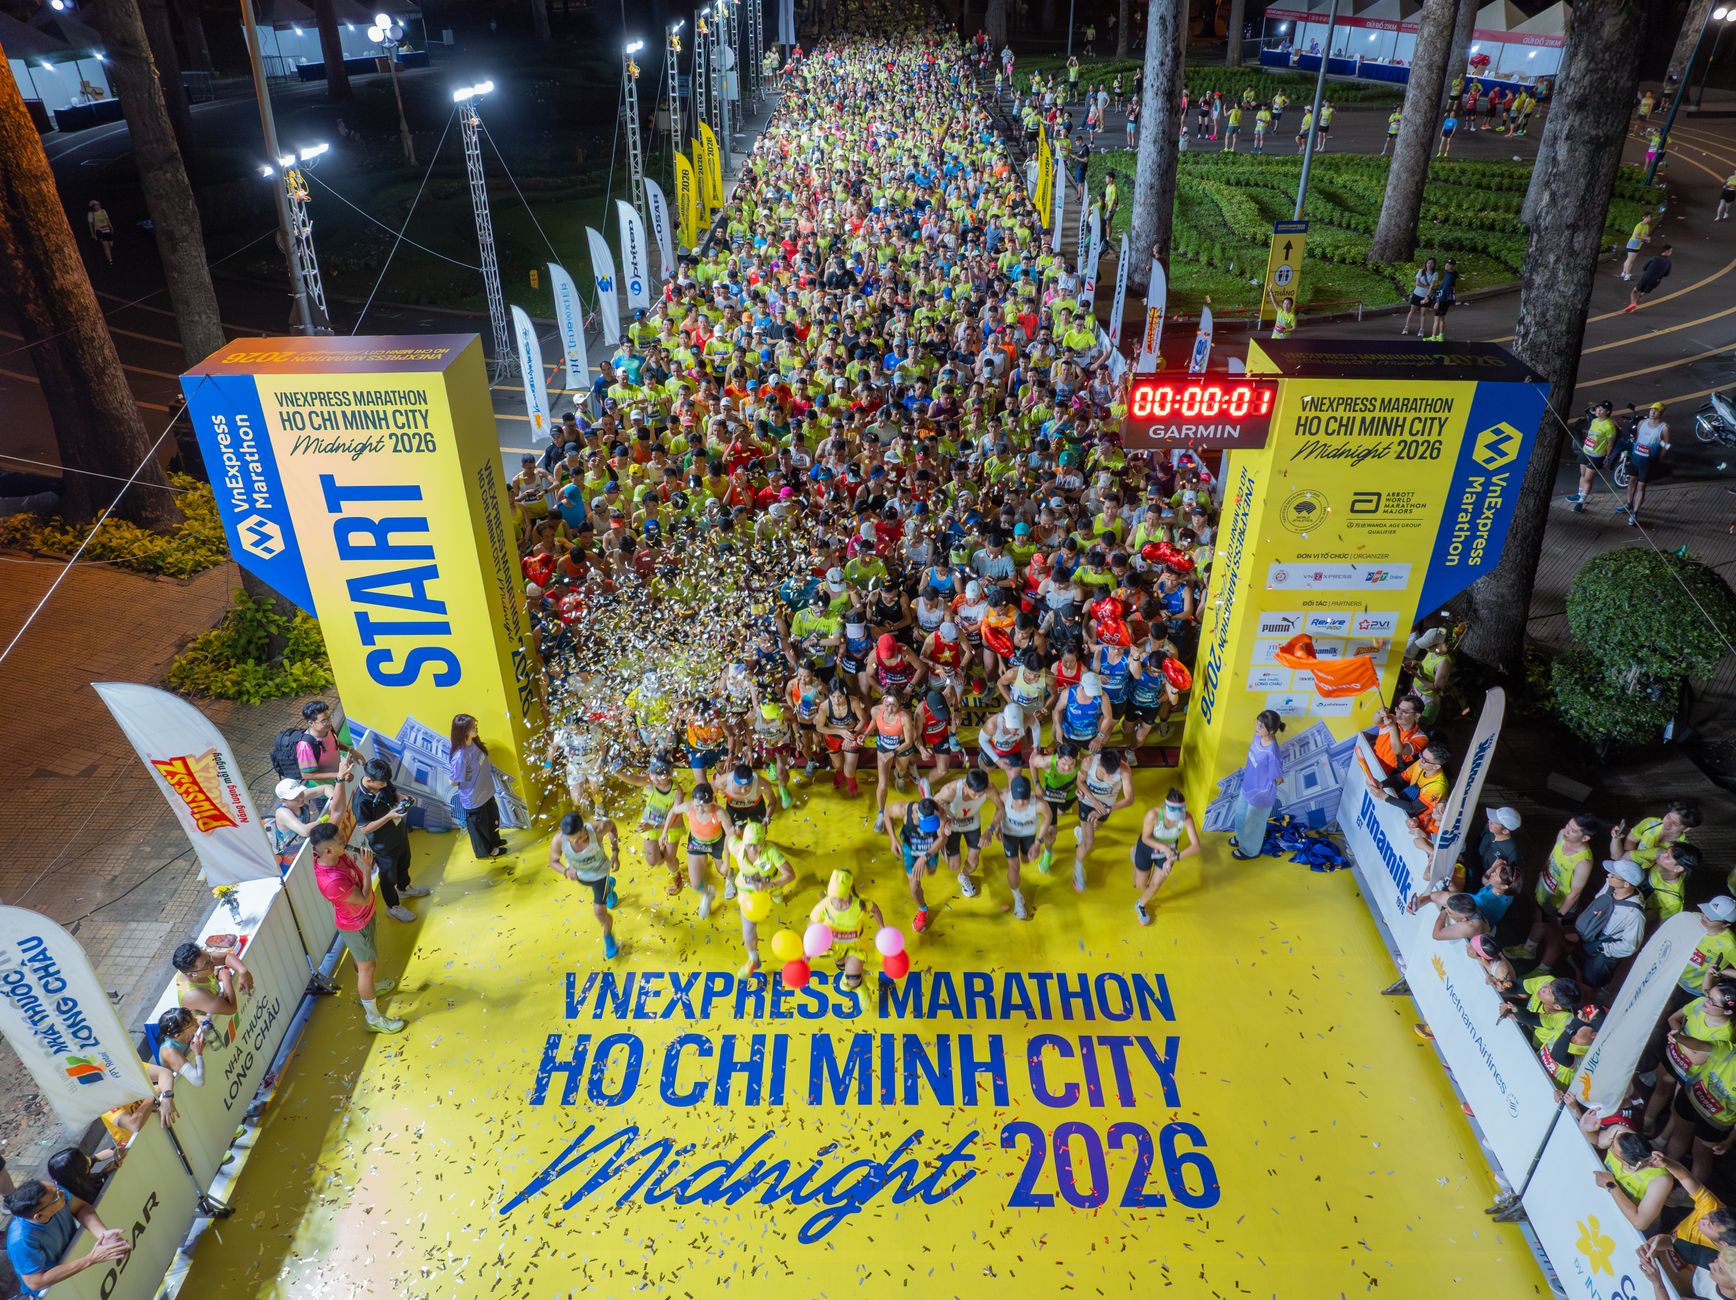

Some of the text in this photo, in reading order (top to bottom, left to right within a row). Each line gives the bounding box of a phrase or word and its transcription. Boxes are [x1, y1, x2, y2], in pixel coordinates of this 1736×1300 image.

[681, 168, 690, 193] 2026
[222, 351, 294, 364] 2026
[274, 390, 428, 407] VNEXPRESS MARATHON
[278, 409, 430, 431] HO CHI MINH CITY
[1132, 386, 1271, 416] 00:00:01
[1301, 397, 1454, 414] VNEXPRESS MARATHON
[290, 432, 437, 461] Midnight 2026
[1149, 425, 1241, 439] GARMIN
[1294, 416, 1449, 437] HO CHI MINH CITY
[211, 414, 250, 513] VnExpress
[236, 413, 272, 510] Marathon
[477, 468, 486, 487] HO
[1290, 439, 1443, 467] Midnight 2026
[480, 488, 490, 510] CHI
[483, 458, 506, 552] VNEXPRESS
[1445, 476, 1486, 567] Marathon
[1467, 472, 1510, 567] VnExpress
[485, 509, 498, 547] MINH
[1235, 477, 1256, 573] VNEXPRESS
[318, 473, 462, 688] START
[1262, 623, 1290, 633] PUMA
[1370, 620, 1390, 628] PVI
[1200, 642, 1222, 725] 2026
[1360, 788, 1412, 905] Vinamilk
[16, 934, 100, 1060] LONG CHÂU
[561, 971, 1177, 1022] VNEXPRESS MARATHON
[223, 998, 282, 1112] LONG CHÂU
[224, 1046, 245, 1081] NHÀ
[240, 992, 271, 1049] THUỐC
[1445, 975, 1508, 1095] Vietnam Airlines
[528, 1033, 1182, 1108] HO CHI MINH CITY
[499, 1120, 1222, 1246] Midnight 2026
